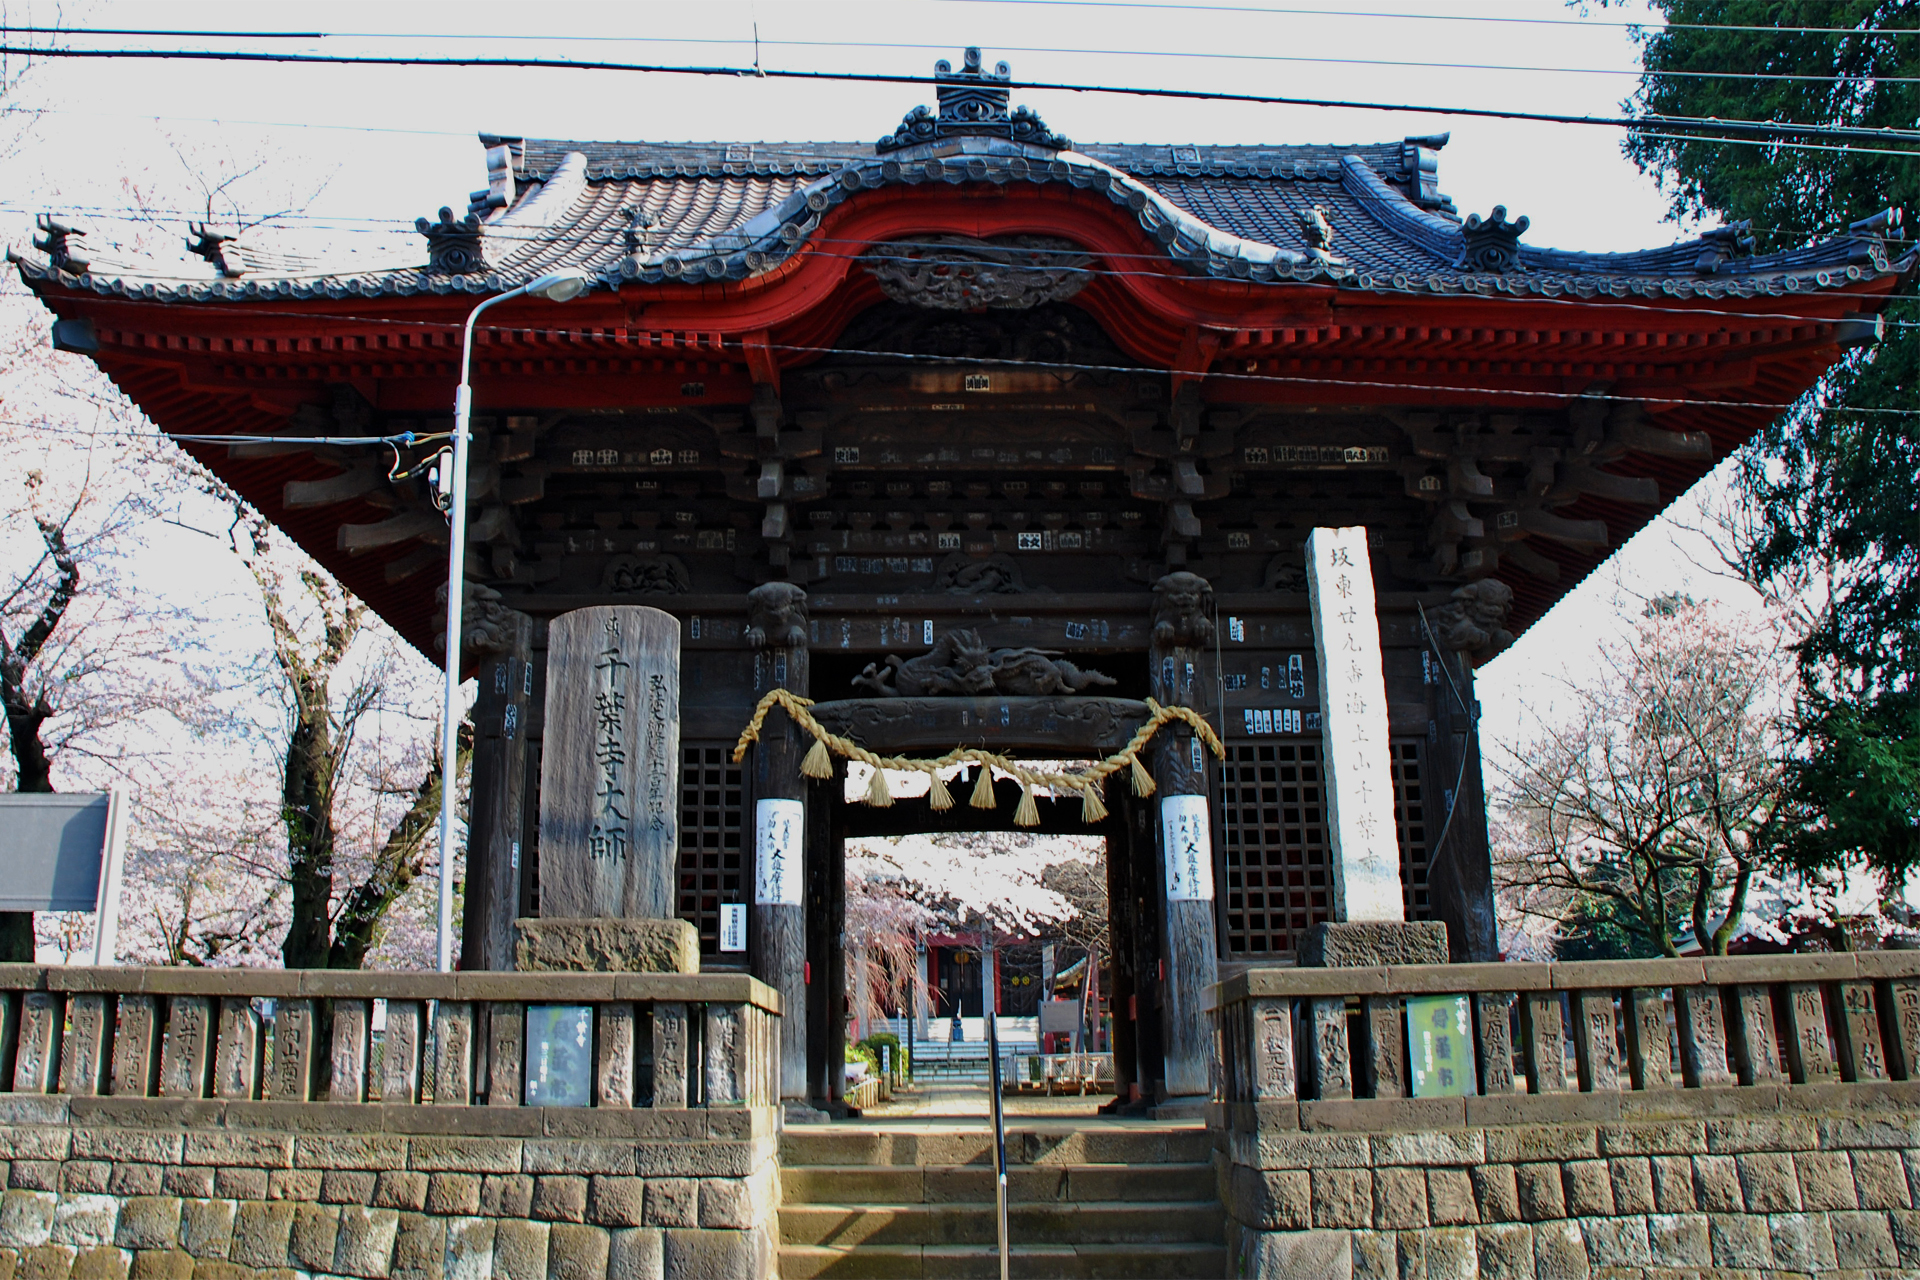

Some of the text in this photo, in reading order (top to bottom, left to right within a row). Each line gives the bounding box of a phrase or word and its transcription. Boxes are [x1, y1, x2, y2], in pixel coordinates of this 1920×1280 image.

[589, 647, 631, 868] 千葉寺大師
